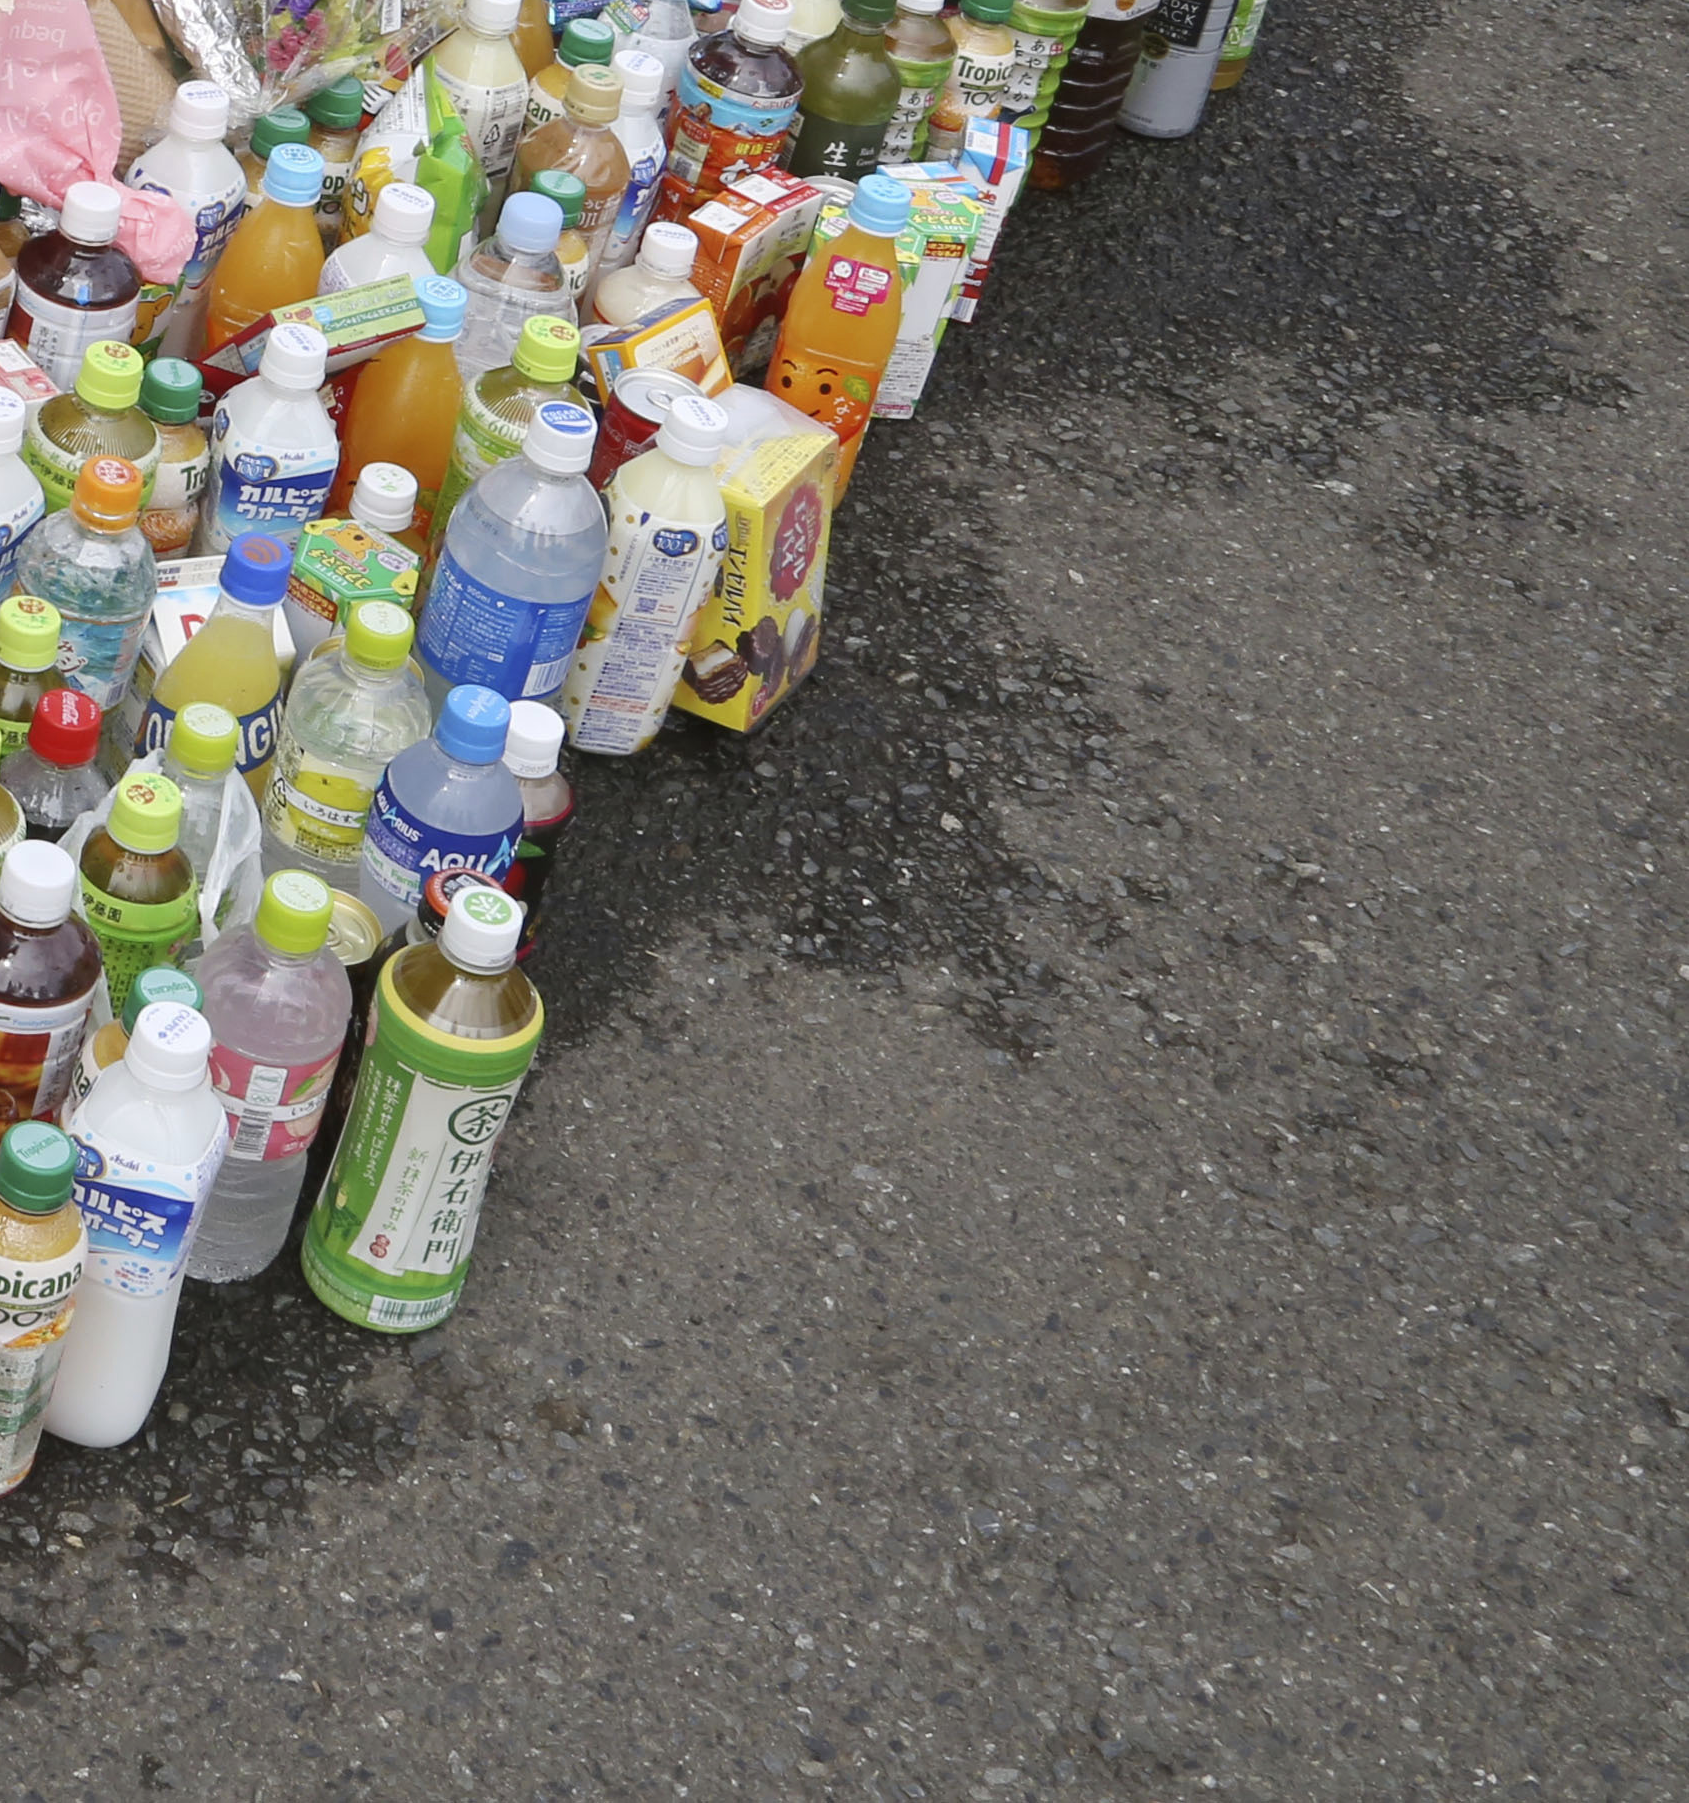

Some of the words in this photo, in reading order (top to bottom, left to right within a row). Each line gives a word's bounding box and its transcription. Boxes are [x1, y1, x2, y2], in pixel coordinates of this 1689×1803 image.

[957, 53, 1015, 83] Tropic
[238, 482, 332, 507] カルピス
[235, 501, 320, 521] ウォーター
[303, 799, 354, 825] いろはす
[374, 789, 422, 843] AQUARIUS
[82, 893, 123, 922] 伊藤園
[464, 1102, 507, 1139] 茶
[17, 1132, 59, 1161] Tropicana
[422, 1148, 483, 1265] 伊右衛門
